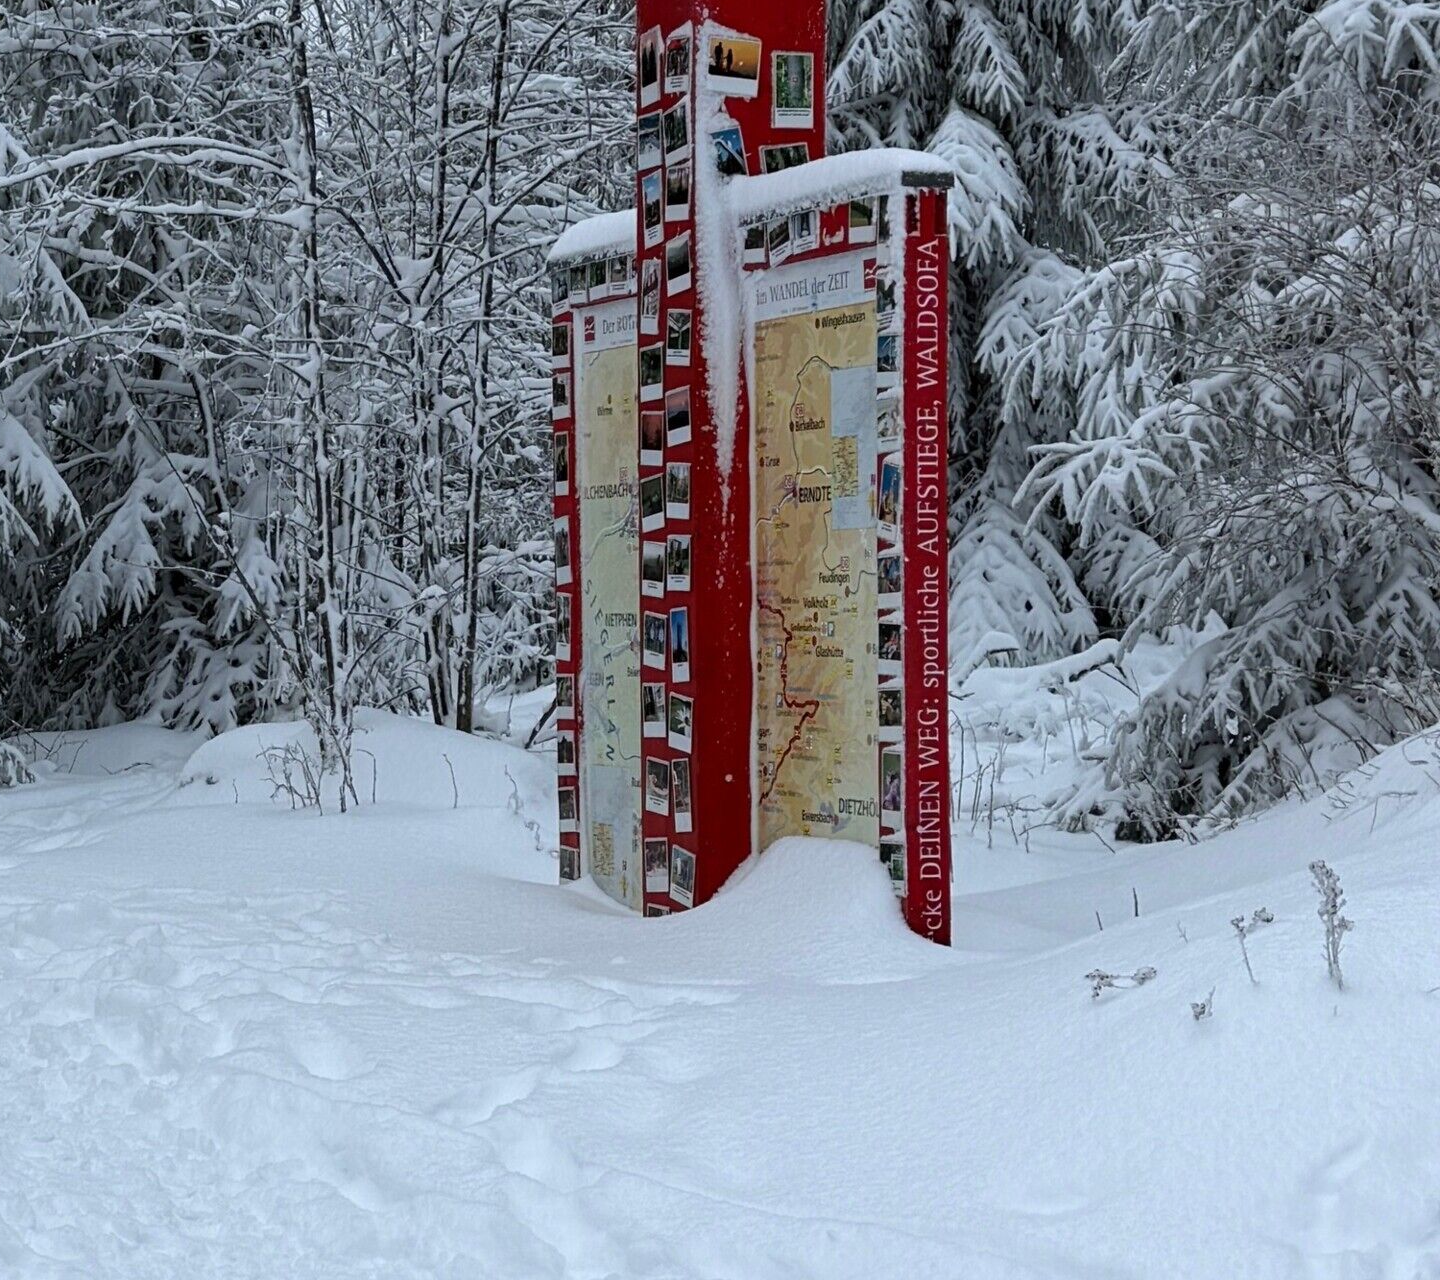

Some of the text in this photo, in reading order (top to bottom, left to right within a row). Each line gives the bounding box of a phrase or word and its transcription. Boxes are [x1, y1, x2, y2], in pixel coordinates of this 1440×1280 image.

[770, 278, 809, 302] WANDEL
[811, 277, 826, 294] der
[828, 271, 849, 292] ZEIT
[916, 238, 939, 391] WALDSOFA
[916, 400, 941, 555] AUFSTIEGE,
[604, 613, 637, 628] NETPHEN
[818, 573, 850, 587] Feudingen
[917, 563, 943, 688] sportliche
[918, 698, 939, 770] WEG:
[920, 780, 941, 881] DEINEN
